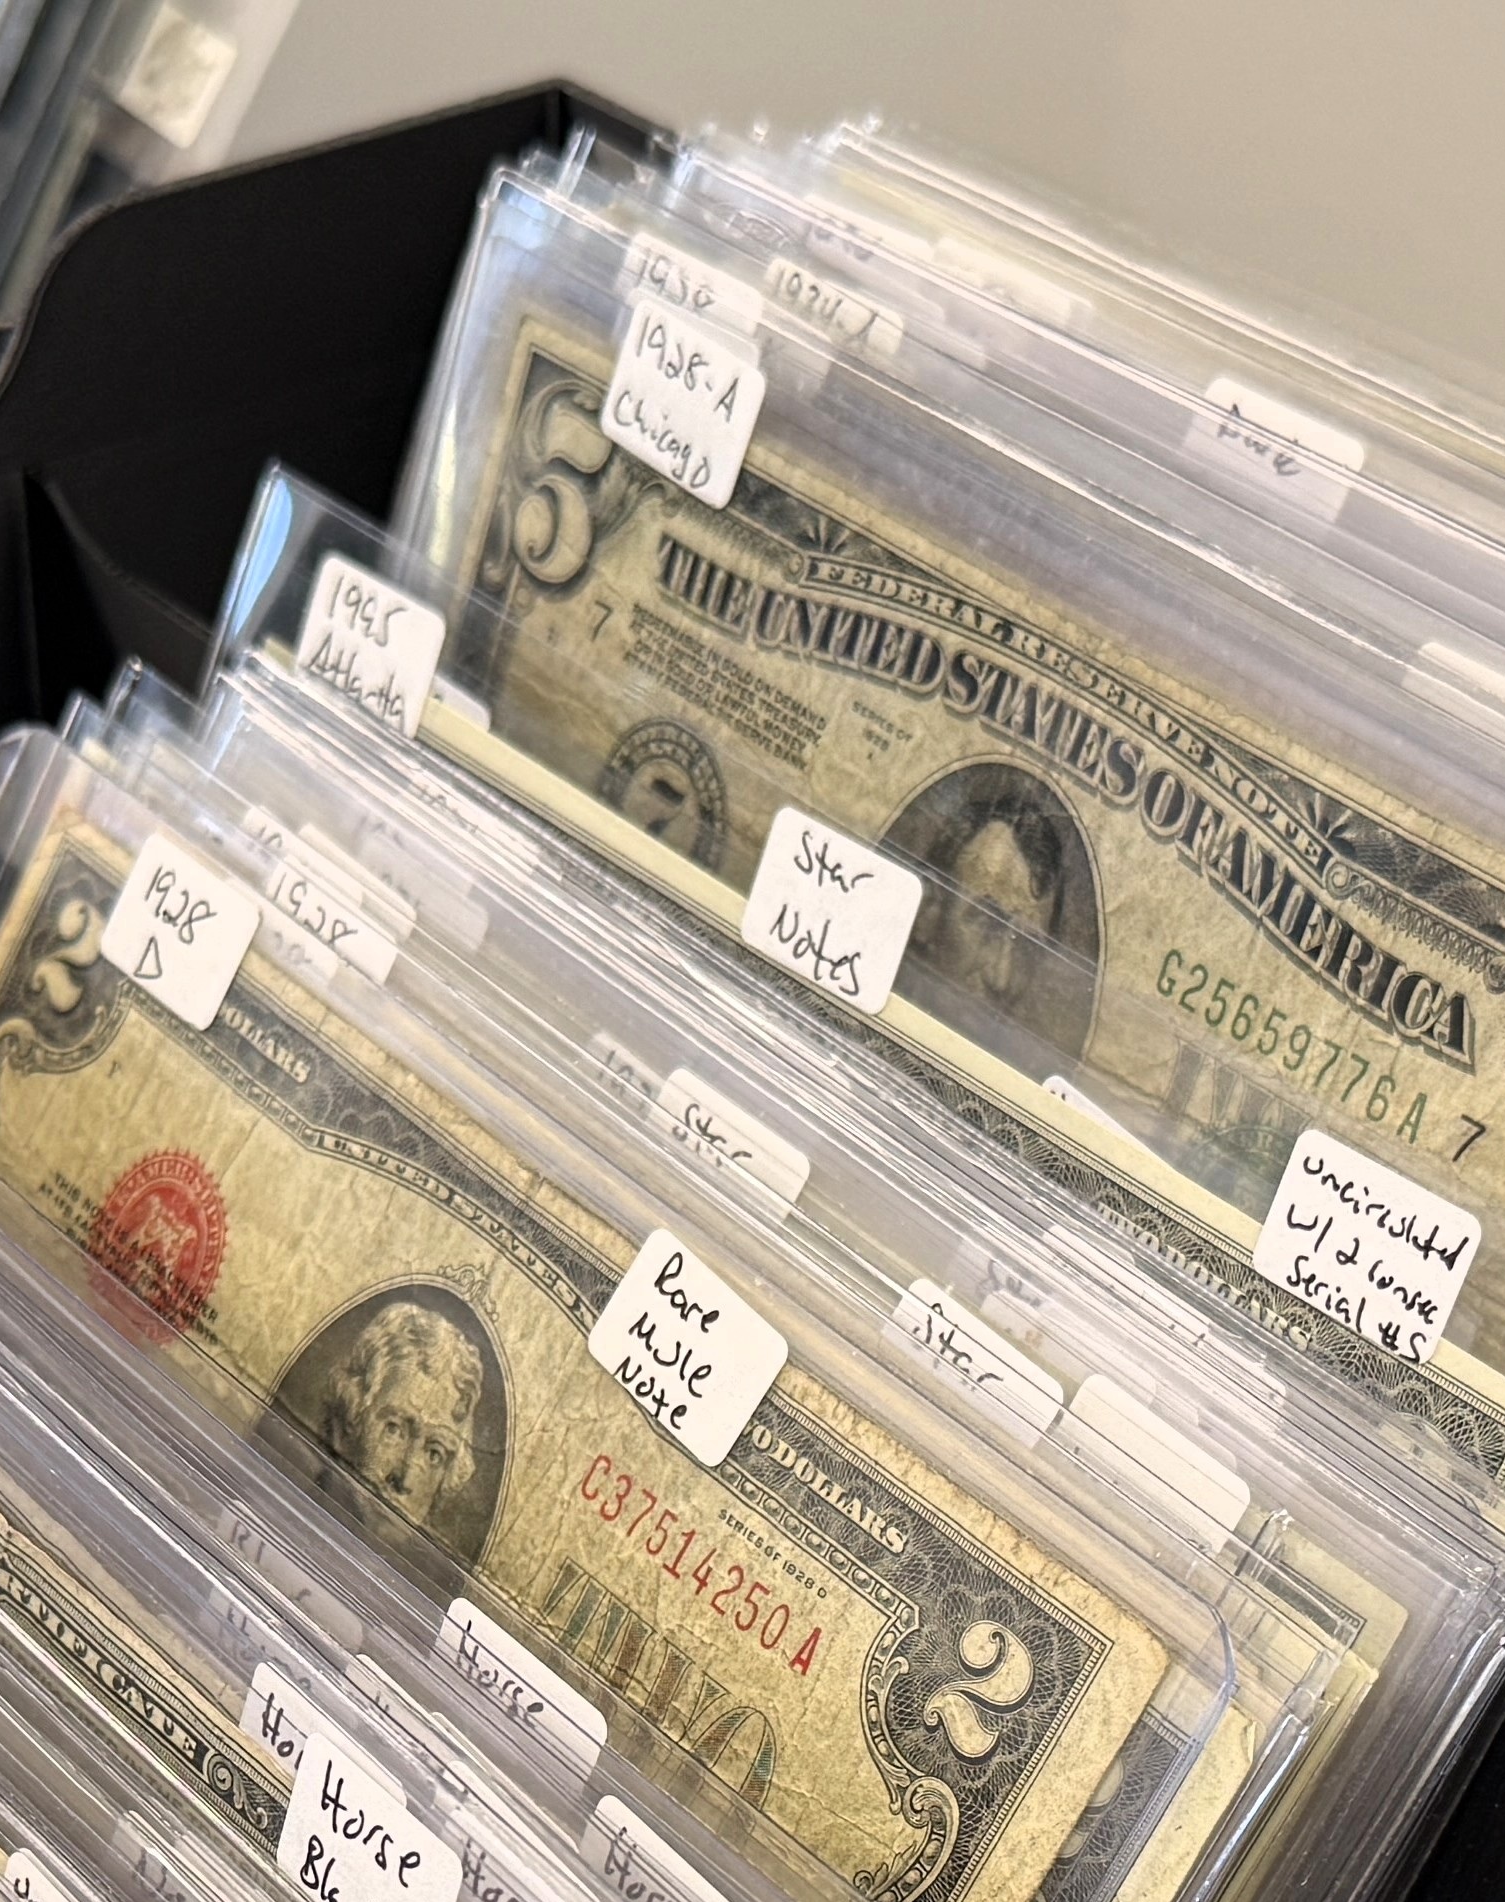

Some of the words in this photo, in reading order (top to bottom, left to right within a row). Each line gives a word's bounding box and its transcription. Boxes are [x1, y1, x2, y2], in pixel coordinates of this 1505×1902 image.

[592, 602, 612, 640] 7
[814, 556, 1006, 650] FEDERAL
[1012, 626, 1201, 770] RESERVE
[1209, 740, 1327, 868] NOTE
[657, 530, 751, 641] THE
[752, 581, 946, 697] UNITED
[941, 645, 1149, 810] STATES
[1142, 769, 1222, 867] OF
[1210, 826, 1477, 1076] AMERICA
[147, 864, 218, 946] 1928
[794, 831, 875, 895] Star
[770, 903, 862, 997] Notes
[1157, 948, 1429, 1145] G25659776A
[1455, 1114, 1487, 1163] 7
[1334, 1227, 1362, 1267] 2
[655, 1251, 721, 1335] Rare
[614, 1357, 689, 1431] Note
[628, 1312, 712, 1399] Mule
[718, 1506, 763, 1550] SERIES
[764, 1544, 781, 1564] OF
[782, 1558, 814, 1591] 1928
[321, 1759, 420, 1888] Horse
